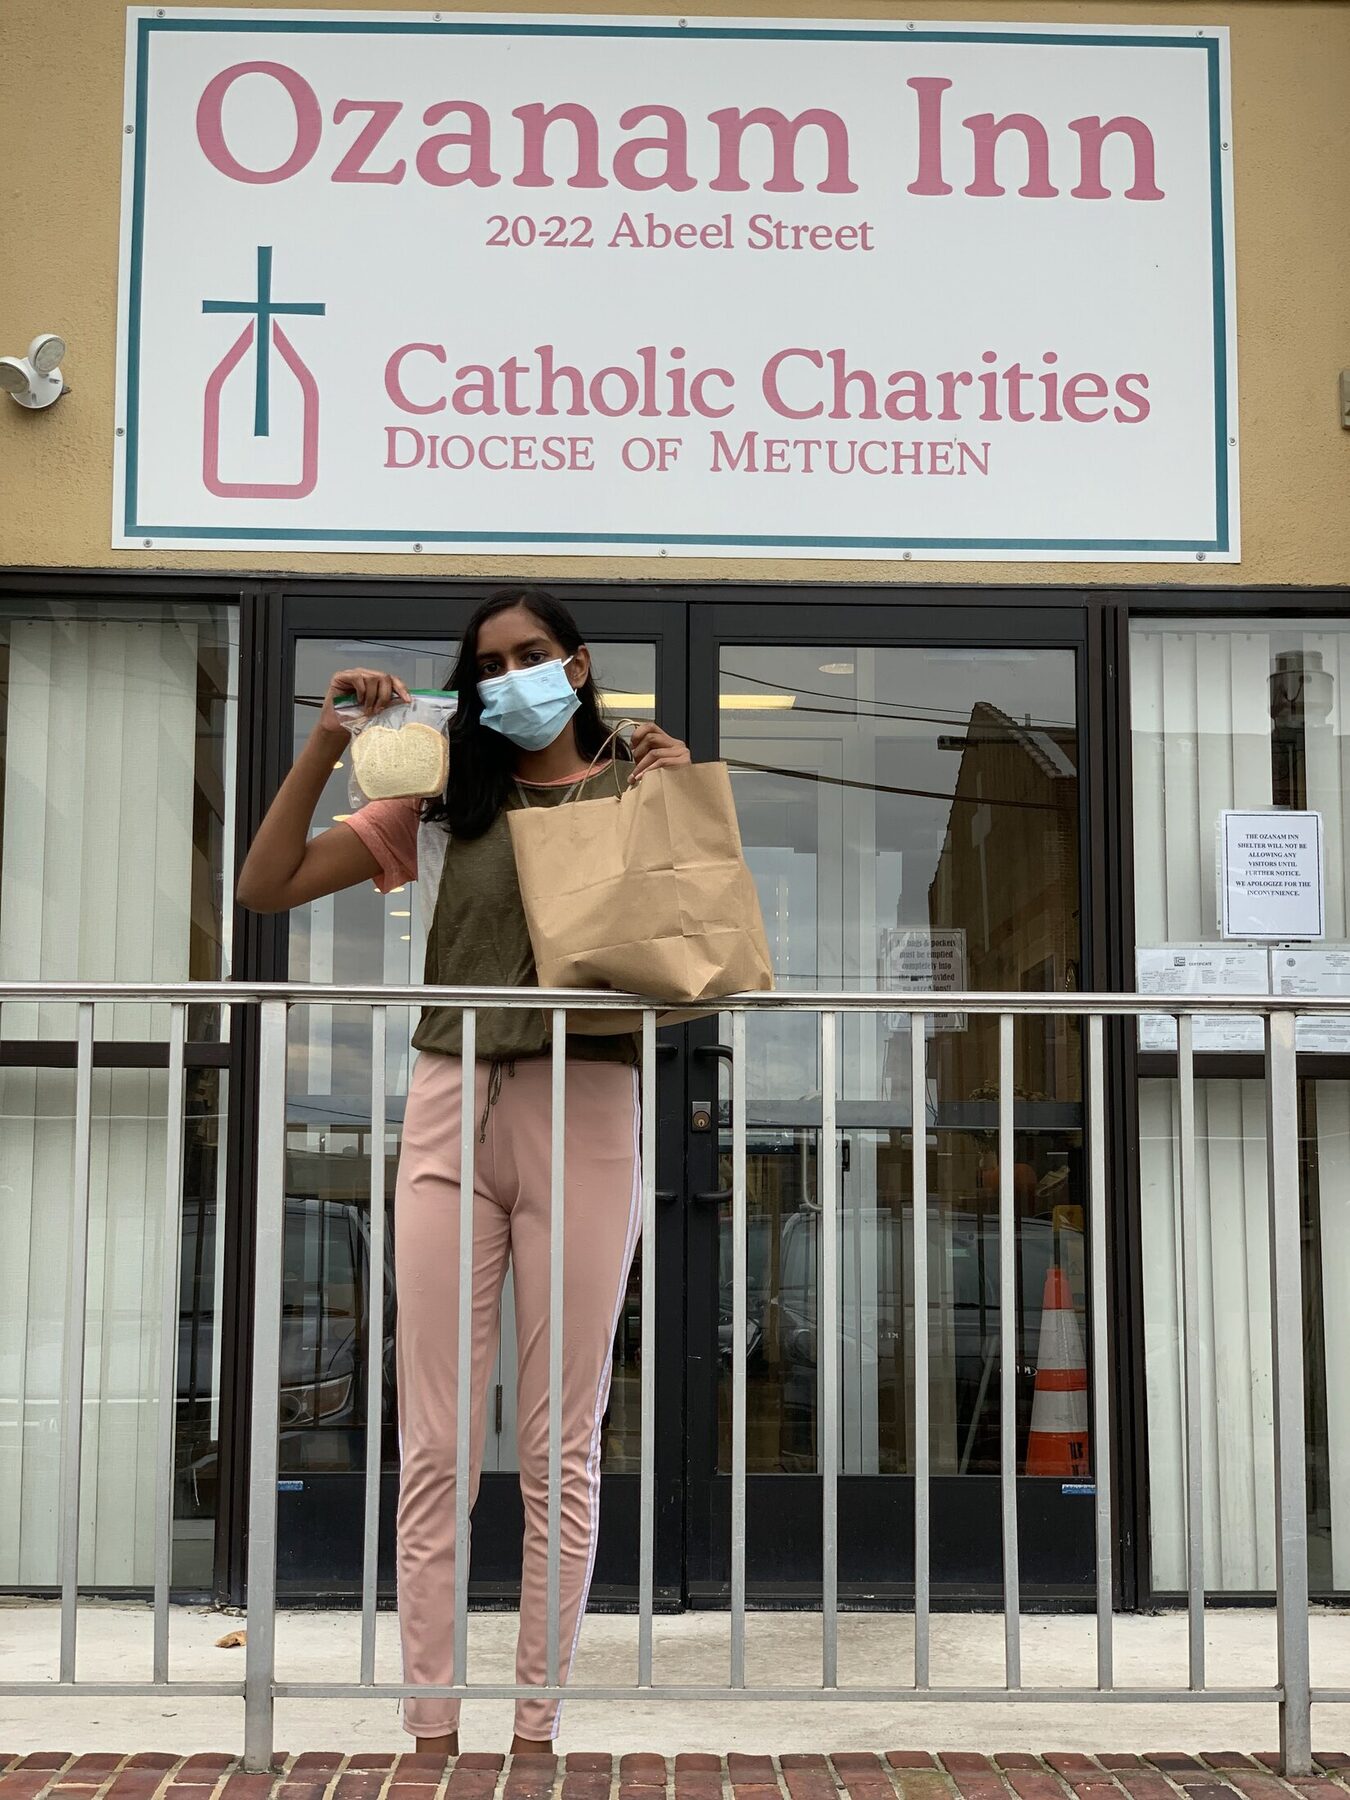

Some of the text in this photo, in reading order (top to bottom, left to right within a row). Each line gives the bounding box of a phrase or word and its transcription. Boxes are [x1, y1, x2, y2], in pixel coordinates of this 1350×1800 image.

[196, 61, 1165, 201] Ozanam Inn
[486, 212, 874, 251] 20-22 Abeel Street
[384, 343, 1151, 423] Catholic Charities
[384, 427, 990, 475] DIOCESE OF METUCHEN
